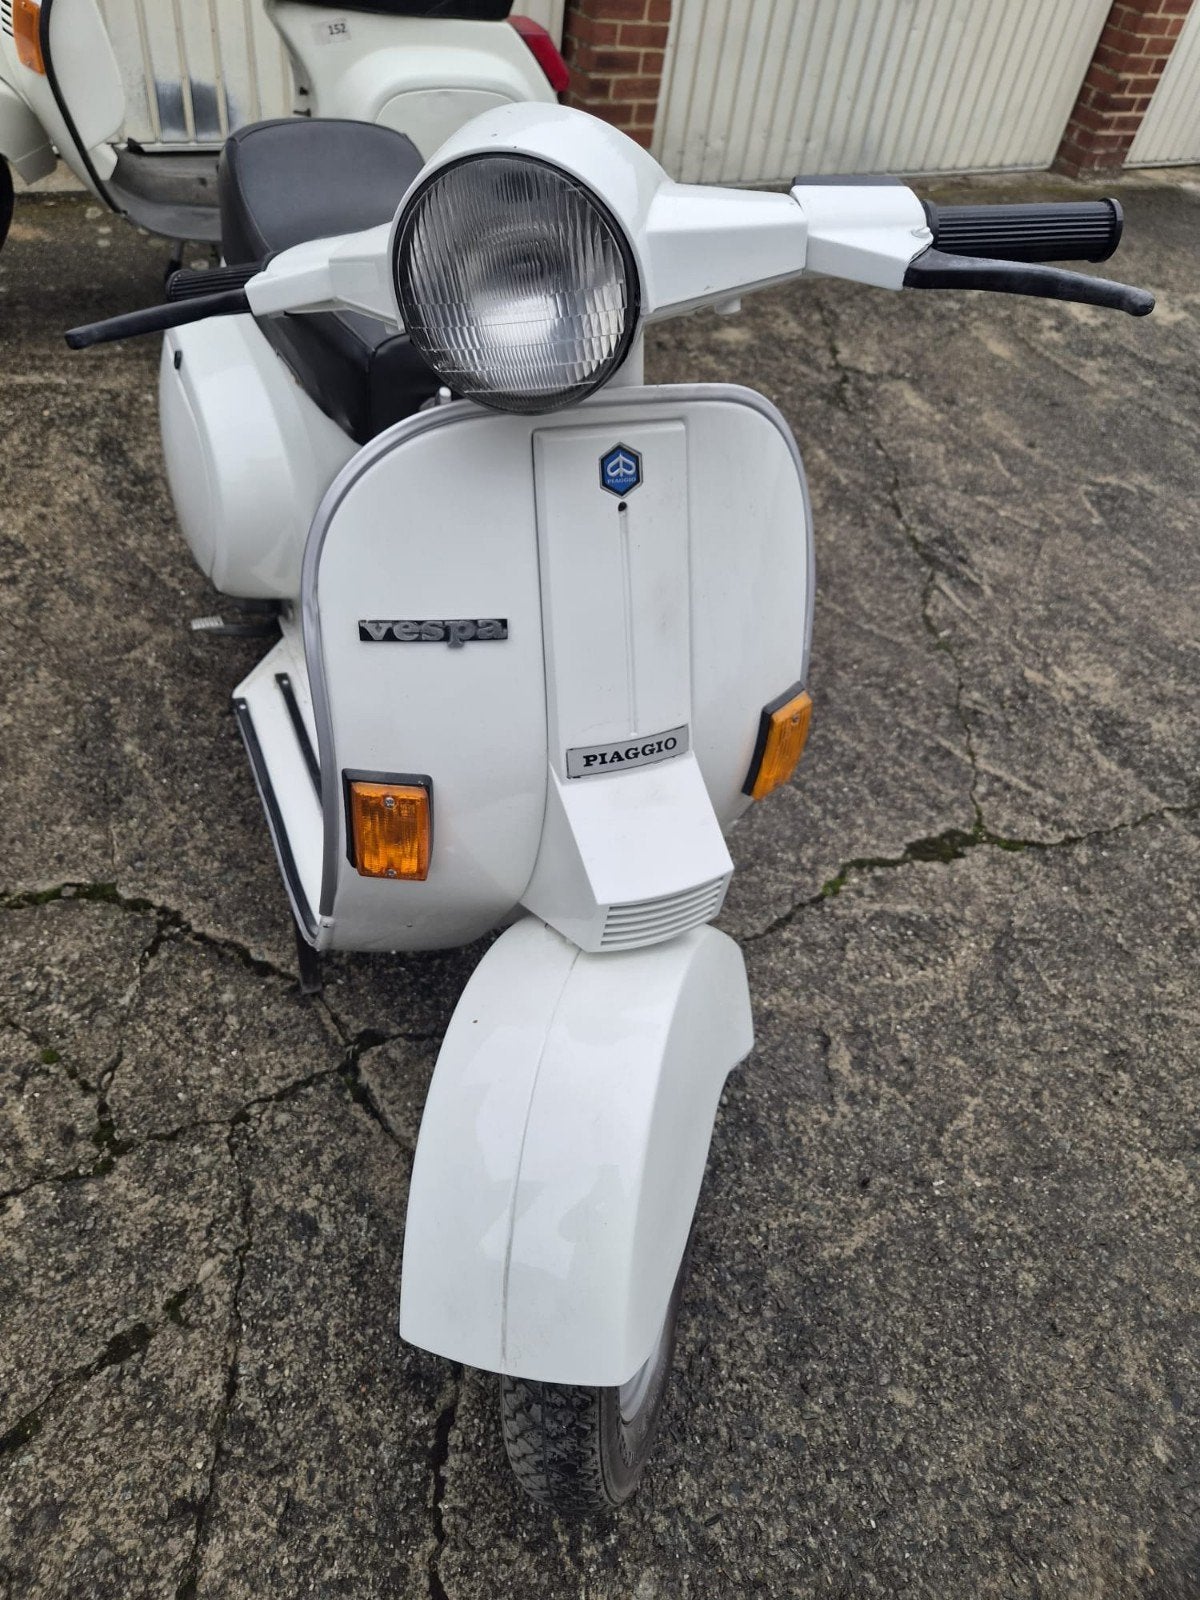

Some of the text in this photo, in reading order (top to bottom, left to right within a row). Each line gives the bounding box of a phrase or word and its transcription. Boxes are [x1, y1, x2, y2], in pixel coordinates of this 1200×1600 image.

[328, 22, 347, 35] 152
[360, 619, 508, 648] vespa
[582, 737, 677, 767] PIAGGIO
